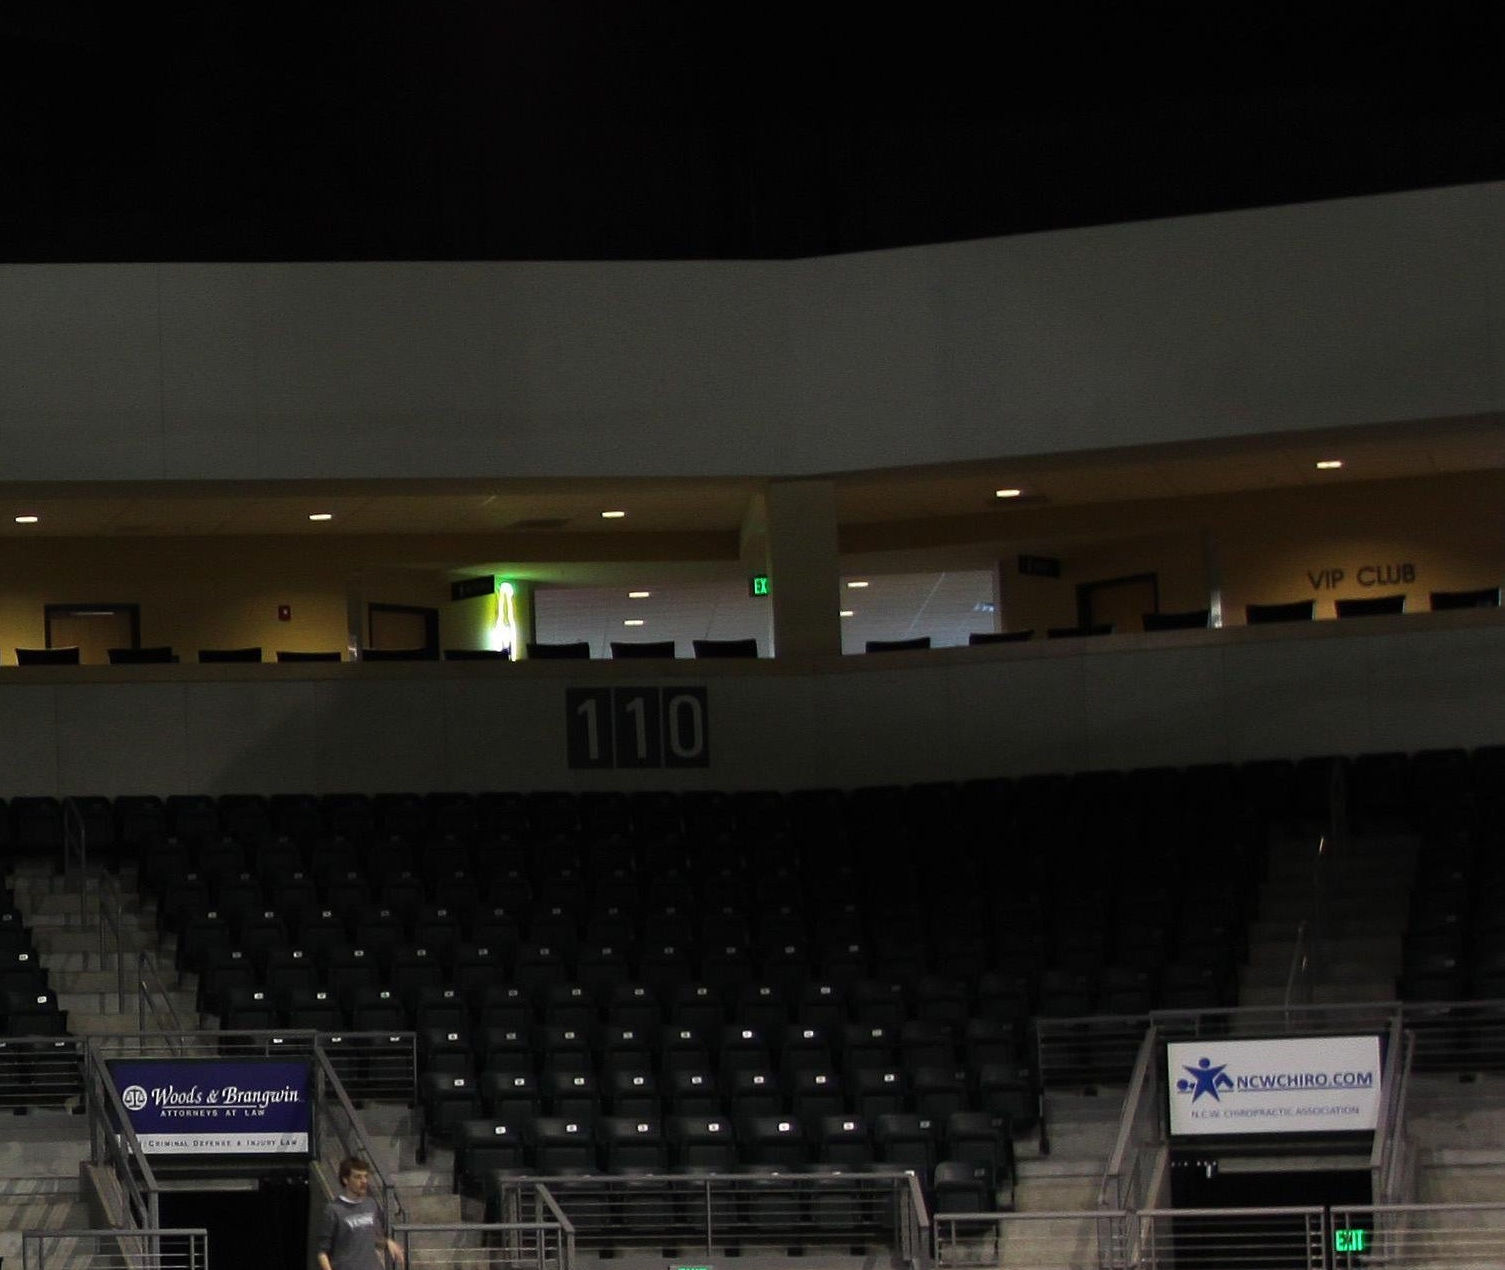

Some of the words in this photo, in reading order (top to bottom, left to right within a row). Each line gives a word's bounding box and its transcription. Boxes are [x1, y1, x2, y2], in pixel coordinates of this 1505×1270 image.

[1306, 569, 1345, 591] VIP
[1356, 563, 1416, 588] CLUB
[577, 694, 703, 760] 110
[1237, 1073, 1373, 1090] NCWCHIRO.COM
[151, 1085, 202, 1106] Woods
[206, 1090, 219, 1104] &
[222, 1085, 300, 1109] Brangwin
[225, 1109, 236, 1117] AT
[245, 1109, 265, 1117] LAW
[1336, 1229, 1364, 1251] EXIT
